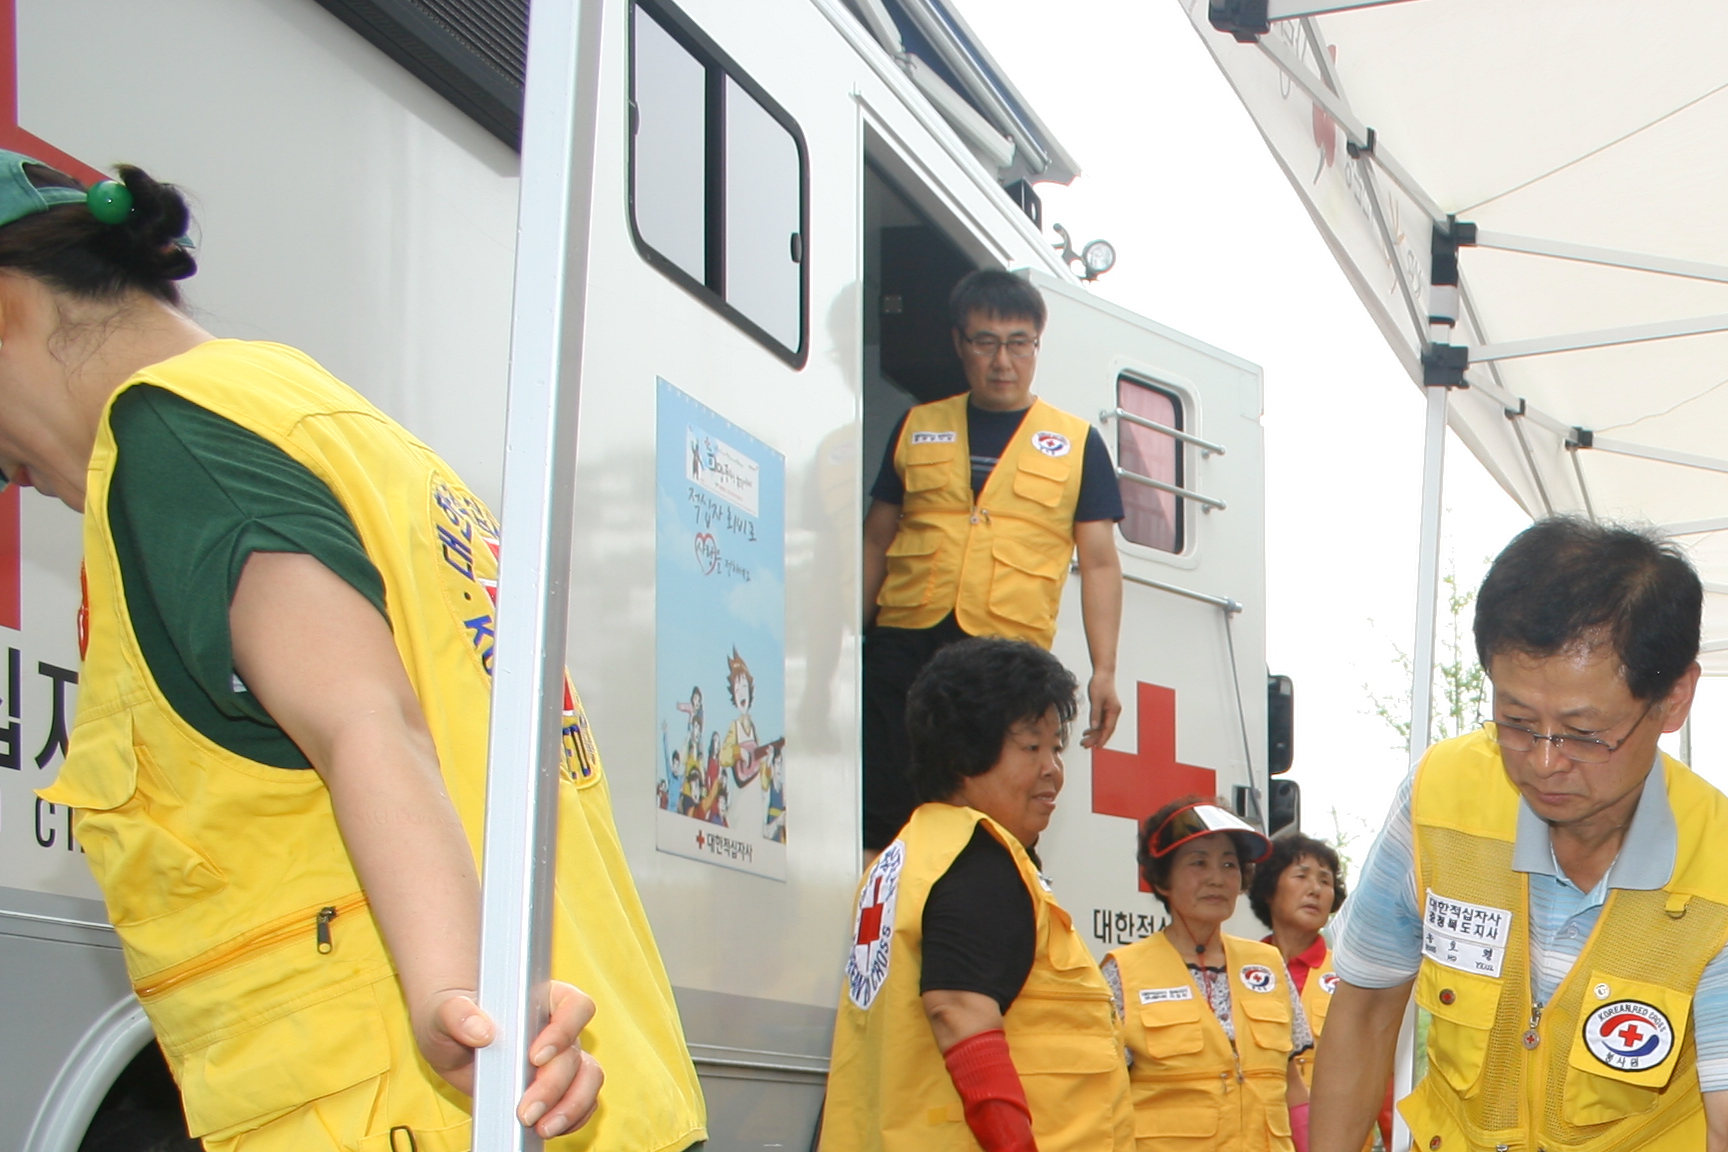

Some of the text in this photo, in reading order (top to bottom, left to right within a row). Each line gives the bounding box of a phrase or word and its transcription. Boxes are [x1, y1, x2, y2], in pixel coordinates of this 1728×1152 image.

[707, 833, 753, 864] 대한적십자사
[1428, 911, 1498, 940] 충청북도지사
[1429, 897, 1502, 927] 대한적십자사
[871, 925, 891, 991] CROSS
[1598, 1003, 1667, 1033] KOREAN RED CROSS
